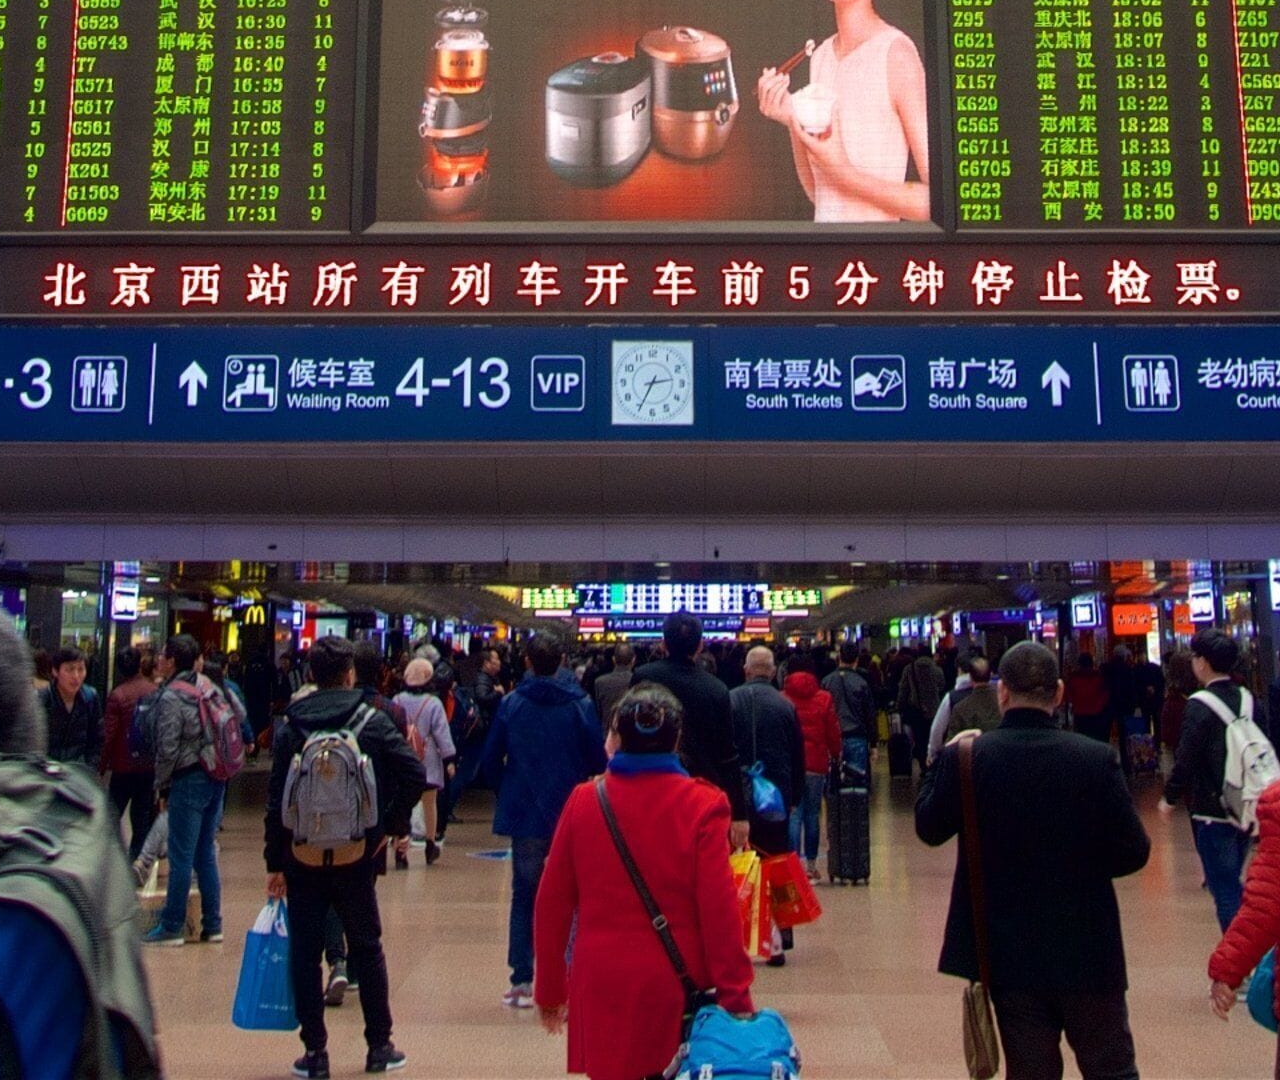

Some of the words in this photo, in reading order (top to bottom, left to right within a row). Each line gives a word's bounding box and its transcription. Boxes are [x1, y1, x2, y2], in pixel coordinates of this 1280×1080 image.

[38, 15, 49, 29] 7
[952, 10, 985, 28] Z95
[1033, 8, 1092, 29] 重庆北
[1112, 10, 1164, 28] 18:06
[27, 99, 46, 116] 11
[152, 95, 211, 116] 太原南
[231, 98, 283, 116] 16:58
[314, 98, 326, 115] 9
[30, 120, 41, 136] 5
[24, 142, 46, 159] 10
[1040, 136, 1100, 156] 石家庄
[1120, 138, 1171, 156] 18:33
[1200, 138, 1221, 155] 10
[1040, 157, 1101, 178] 石家庄
[1121, 159, 1172, 178] 18:39
[1202, 159, 1221, 177] 11
[149, 180, 207, 202] 郑州东
[228, 184, 280, 201] 17:19
[308, 184, 326, 201] 11
[43, 260, 1242, 307] 北京西站所有列车开车前5分钟停止检票。
[288, 357, 375, 388] 候车室
[396, 357, 510, 408] 4-13
[724, 358, 841, 389] 南售票处
[929, 357, 1016, 388] 南广场
[537, 373, 579, 393] VIP
[287, 393, 341, 411] Waiting
[346, 393, 389, 408] Room
[746, 394, 788, 408] South
[792, 394, 843, 408] Tickets
[929, 393, 971, 408] South
[976, 393, 1027, 411] Square
